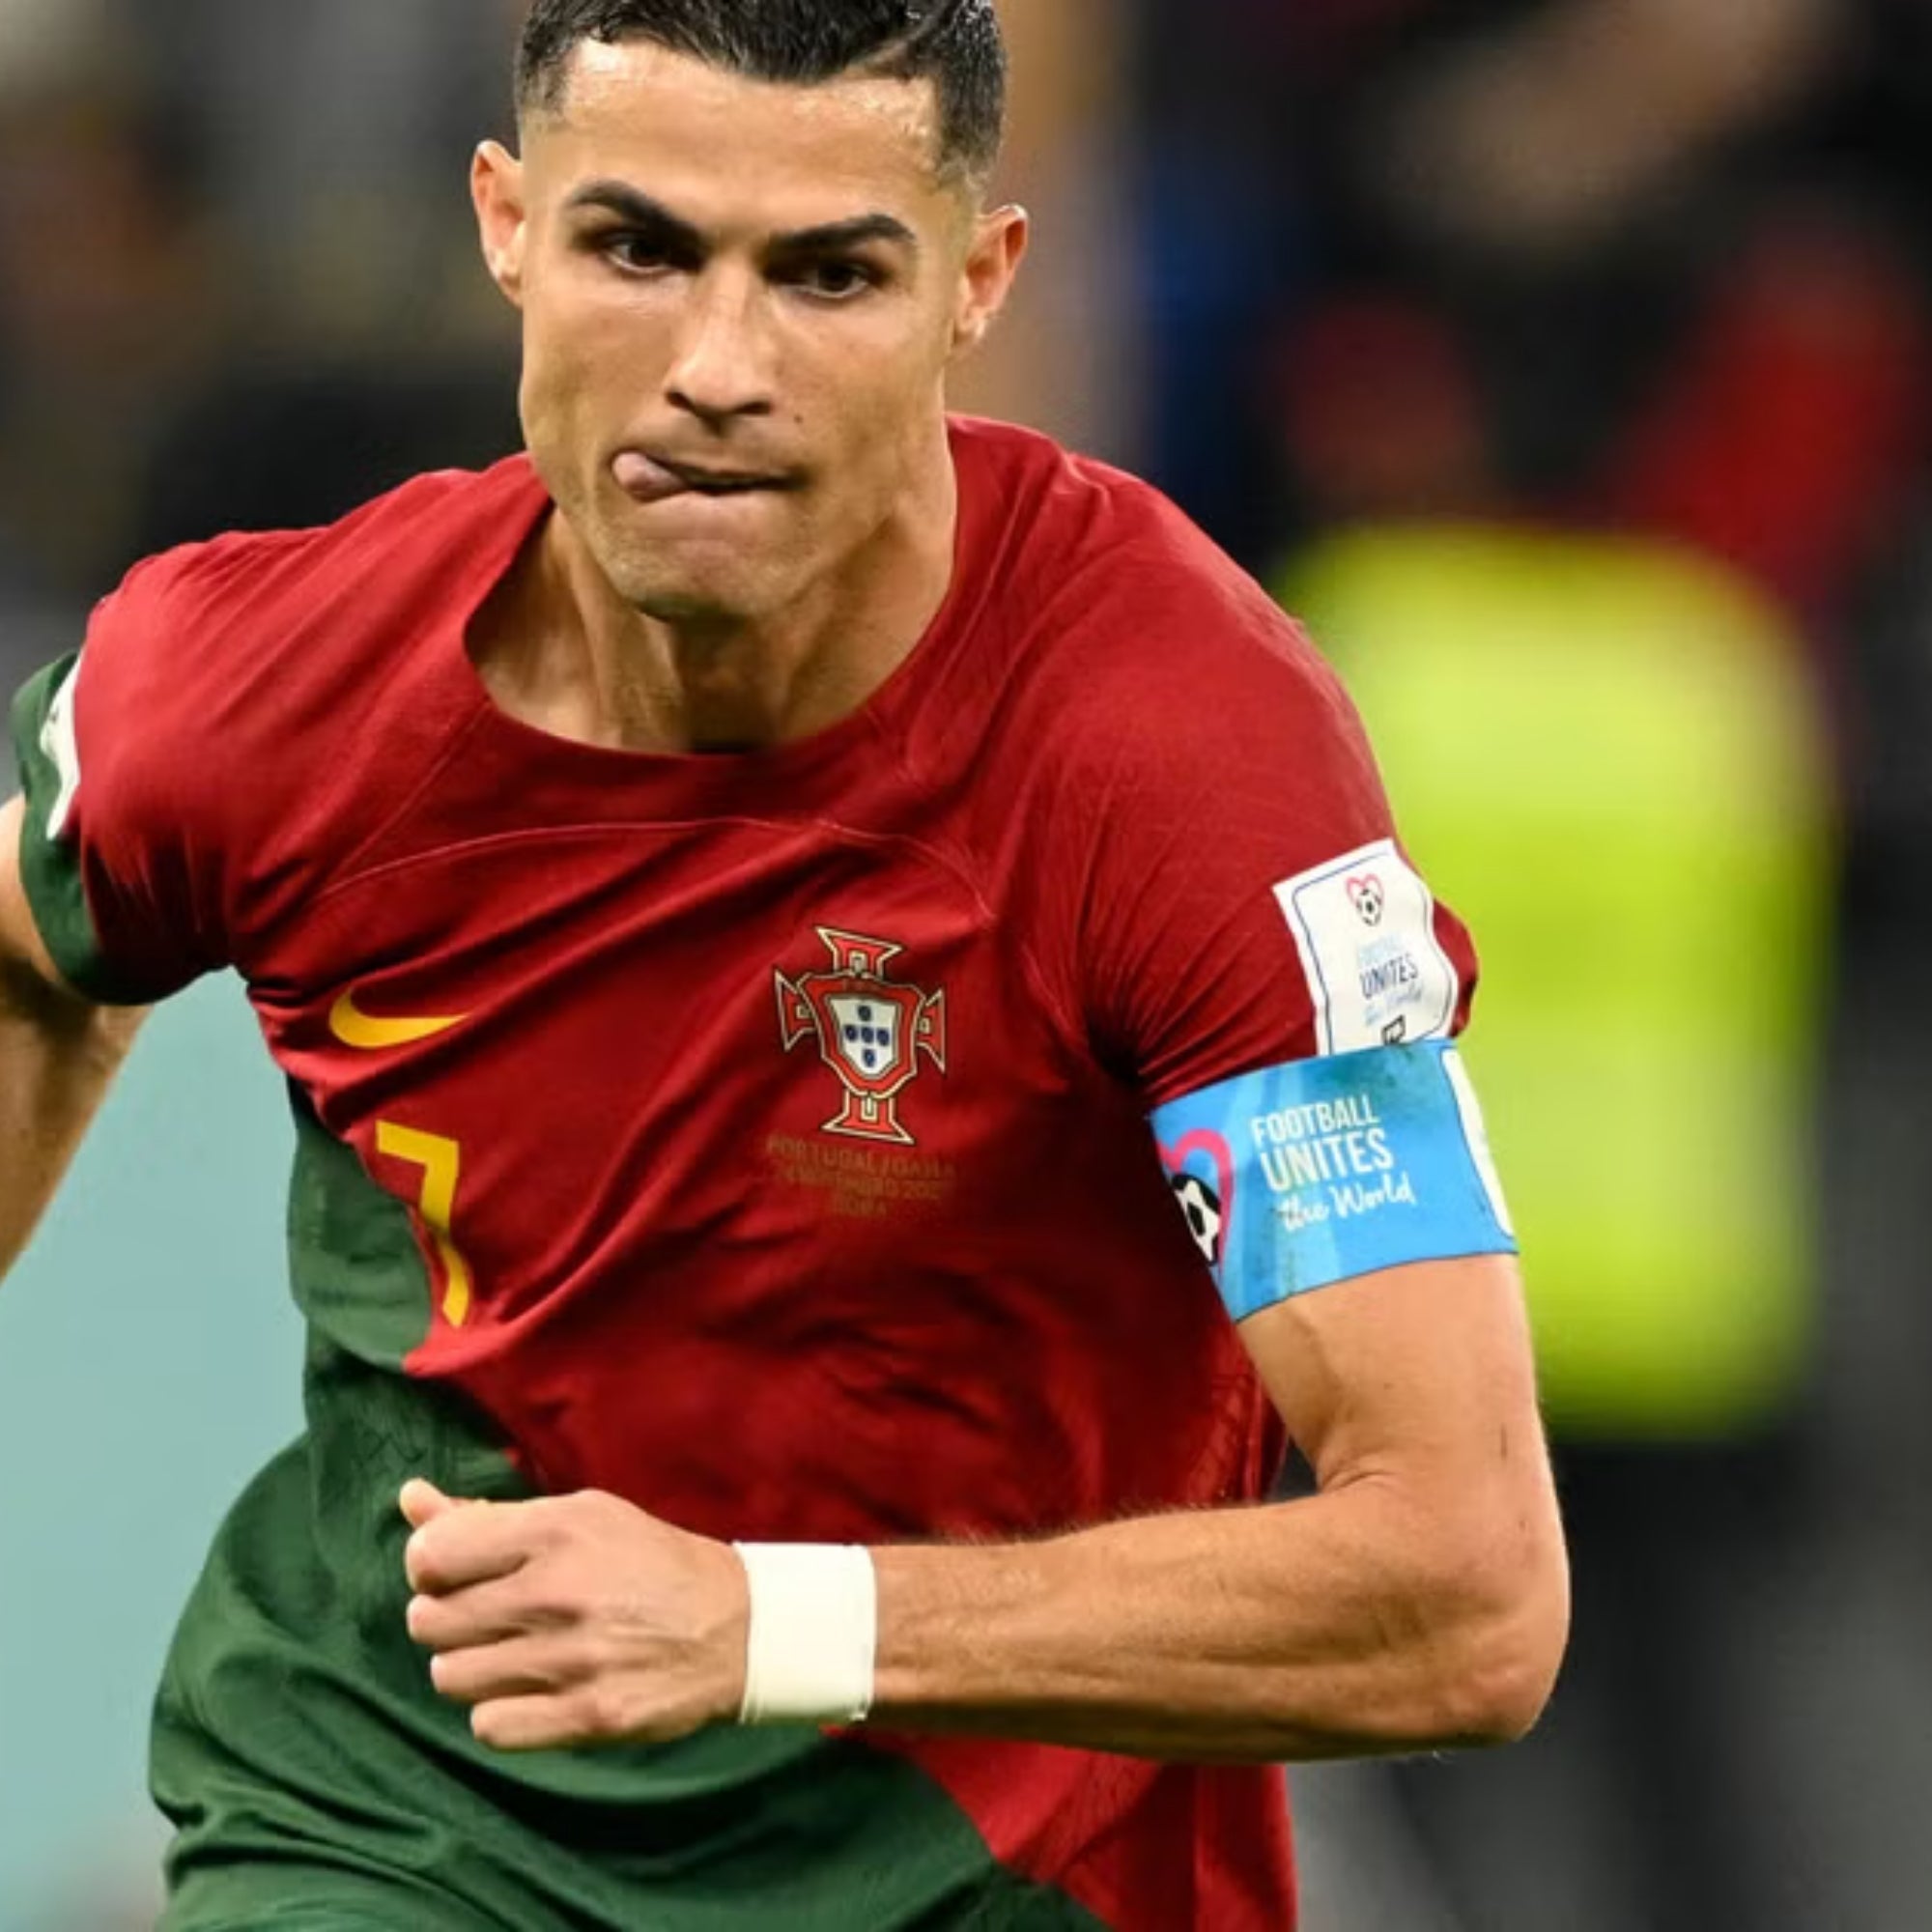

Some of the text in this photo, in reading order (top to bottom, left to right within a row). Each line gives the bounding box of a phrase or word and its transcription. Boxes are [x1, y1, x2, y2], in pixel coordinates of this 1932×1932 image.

[1359, 952, 1418, 999] UNITES
[1251, 1094, 1380, 1149] FOOTBALL
[1260, 1127, 1395, 1192] UNITES
[375, 1120, 469, 1328] 7
[1276, 1172, 1417, 1233] the World
